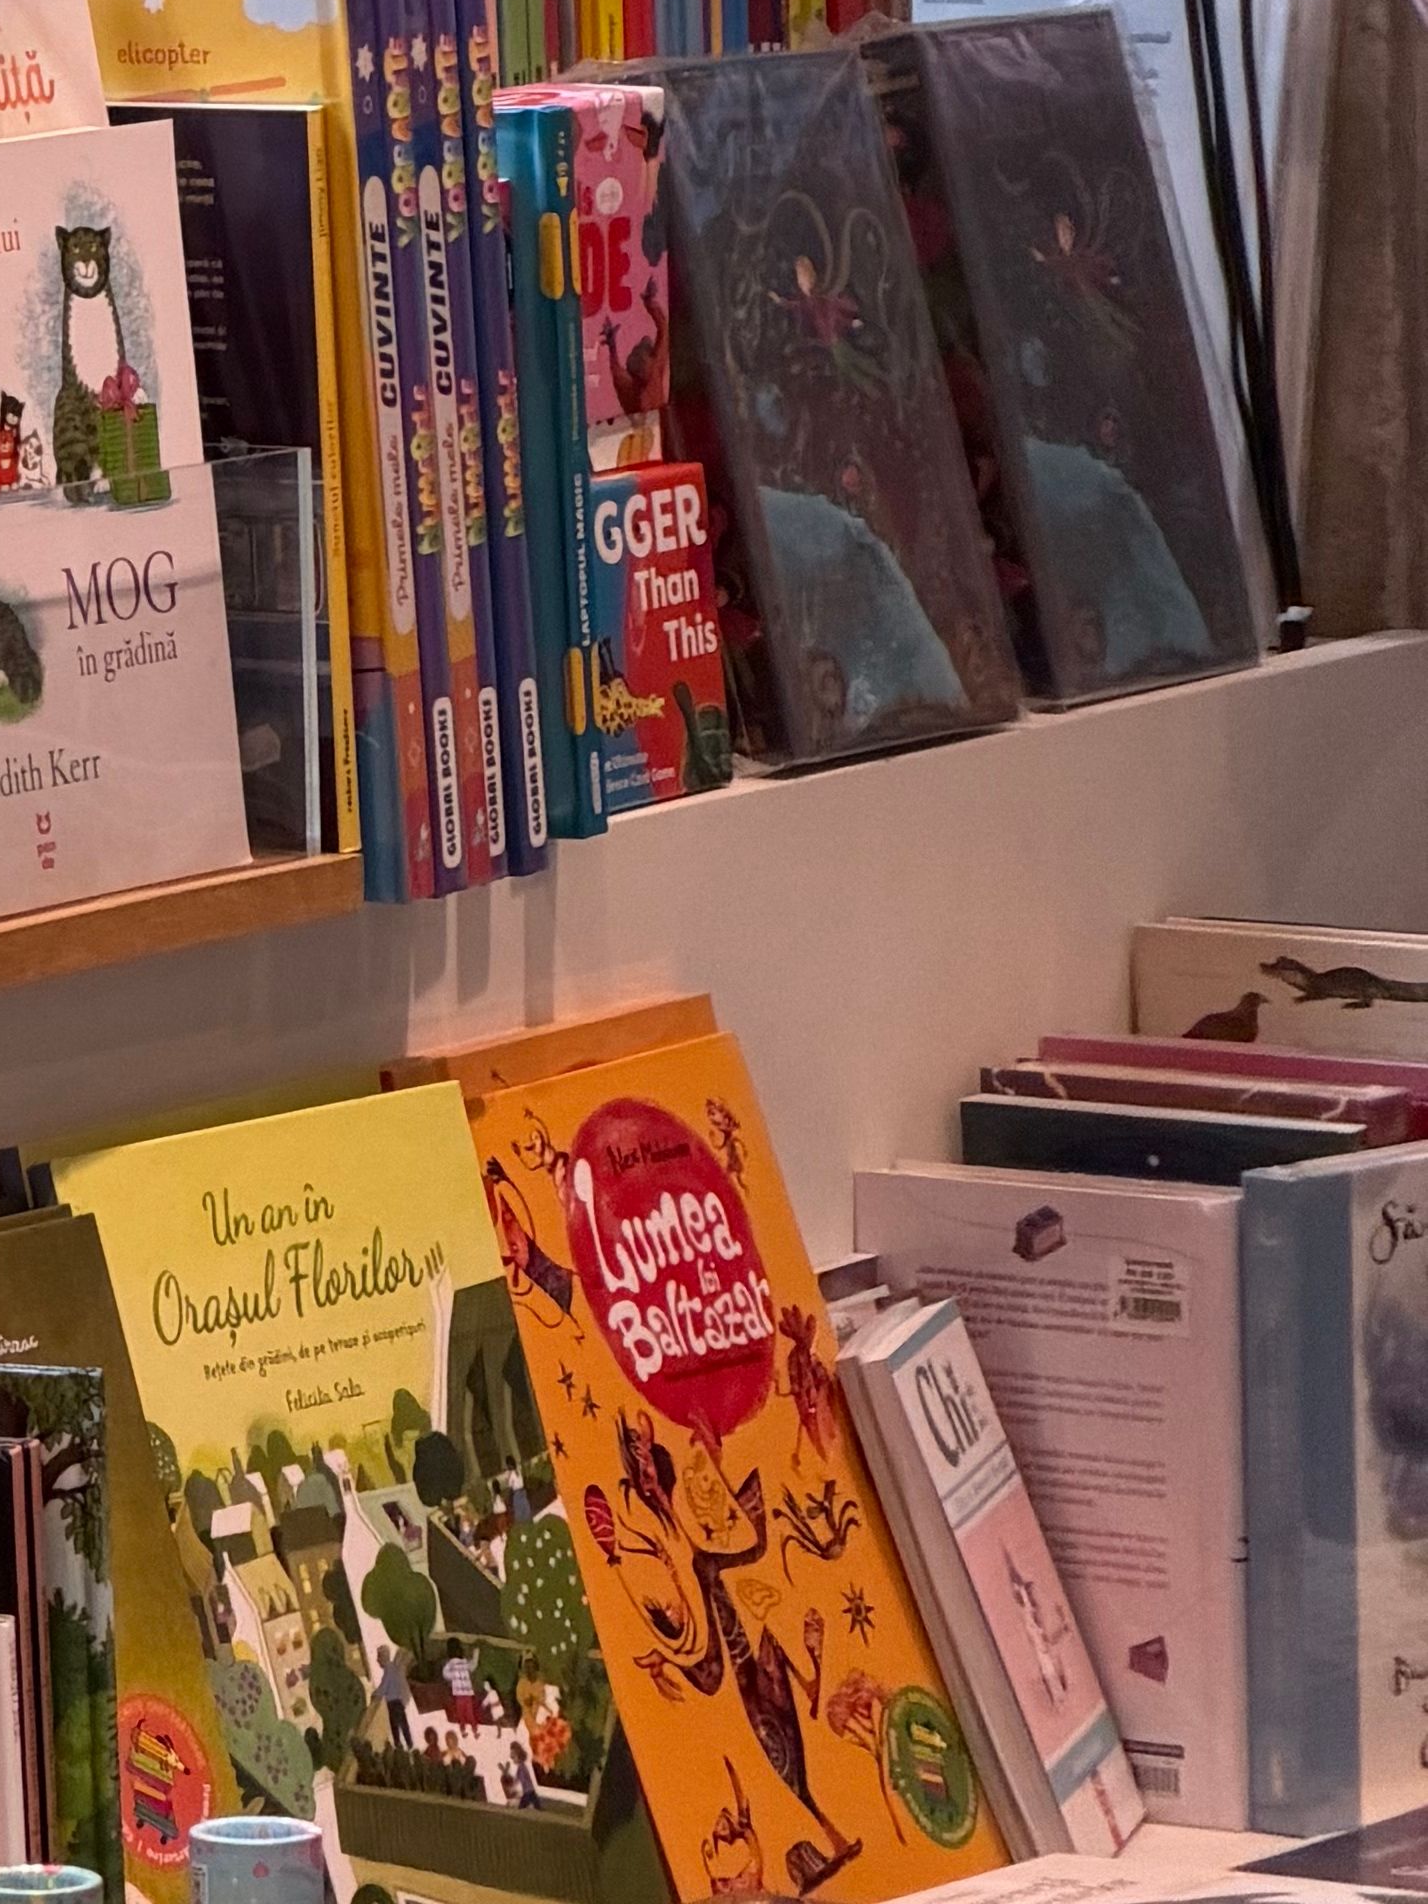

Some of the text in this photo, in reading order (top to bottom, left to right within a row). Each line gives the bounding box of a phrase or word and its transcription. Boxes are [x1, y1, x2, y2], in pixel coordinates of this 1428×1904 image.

[368, 220, 400, 408] CUVINTE
[422, 208, 455, 396] CUVINTE
[61, 550, 179, 630] MOG
[574, 545, 593, 648] LAPTOPUL
[634, 568, 701, 606] Than
[663, 615, 719, 662] This
[75, 644, 99, 677] în
[47, 747, 101, 789] Kerr
[438, 708, 457, 857] GLOBAL BOOKS
[482, 699, 496, 768] BOOKS
[524, 689, 542, 836] GLOBAL BOOKS
[203, 1182, 335, 1246] Un an în
[574, 1158, 743, 1293] Lumea
[152, 1225, 425, 1348] Orașul Florilor
[608, 1270, 774, 1382] Baltazar
